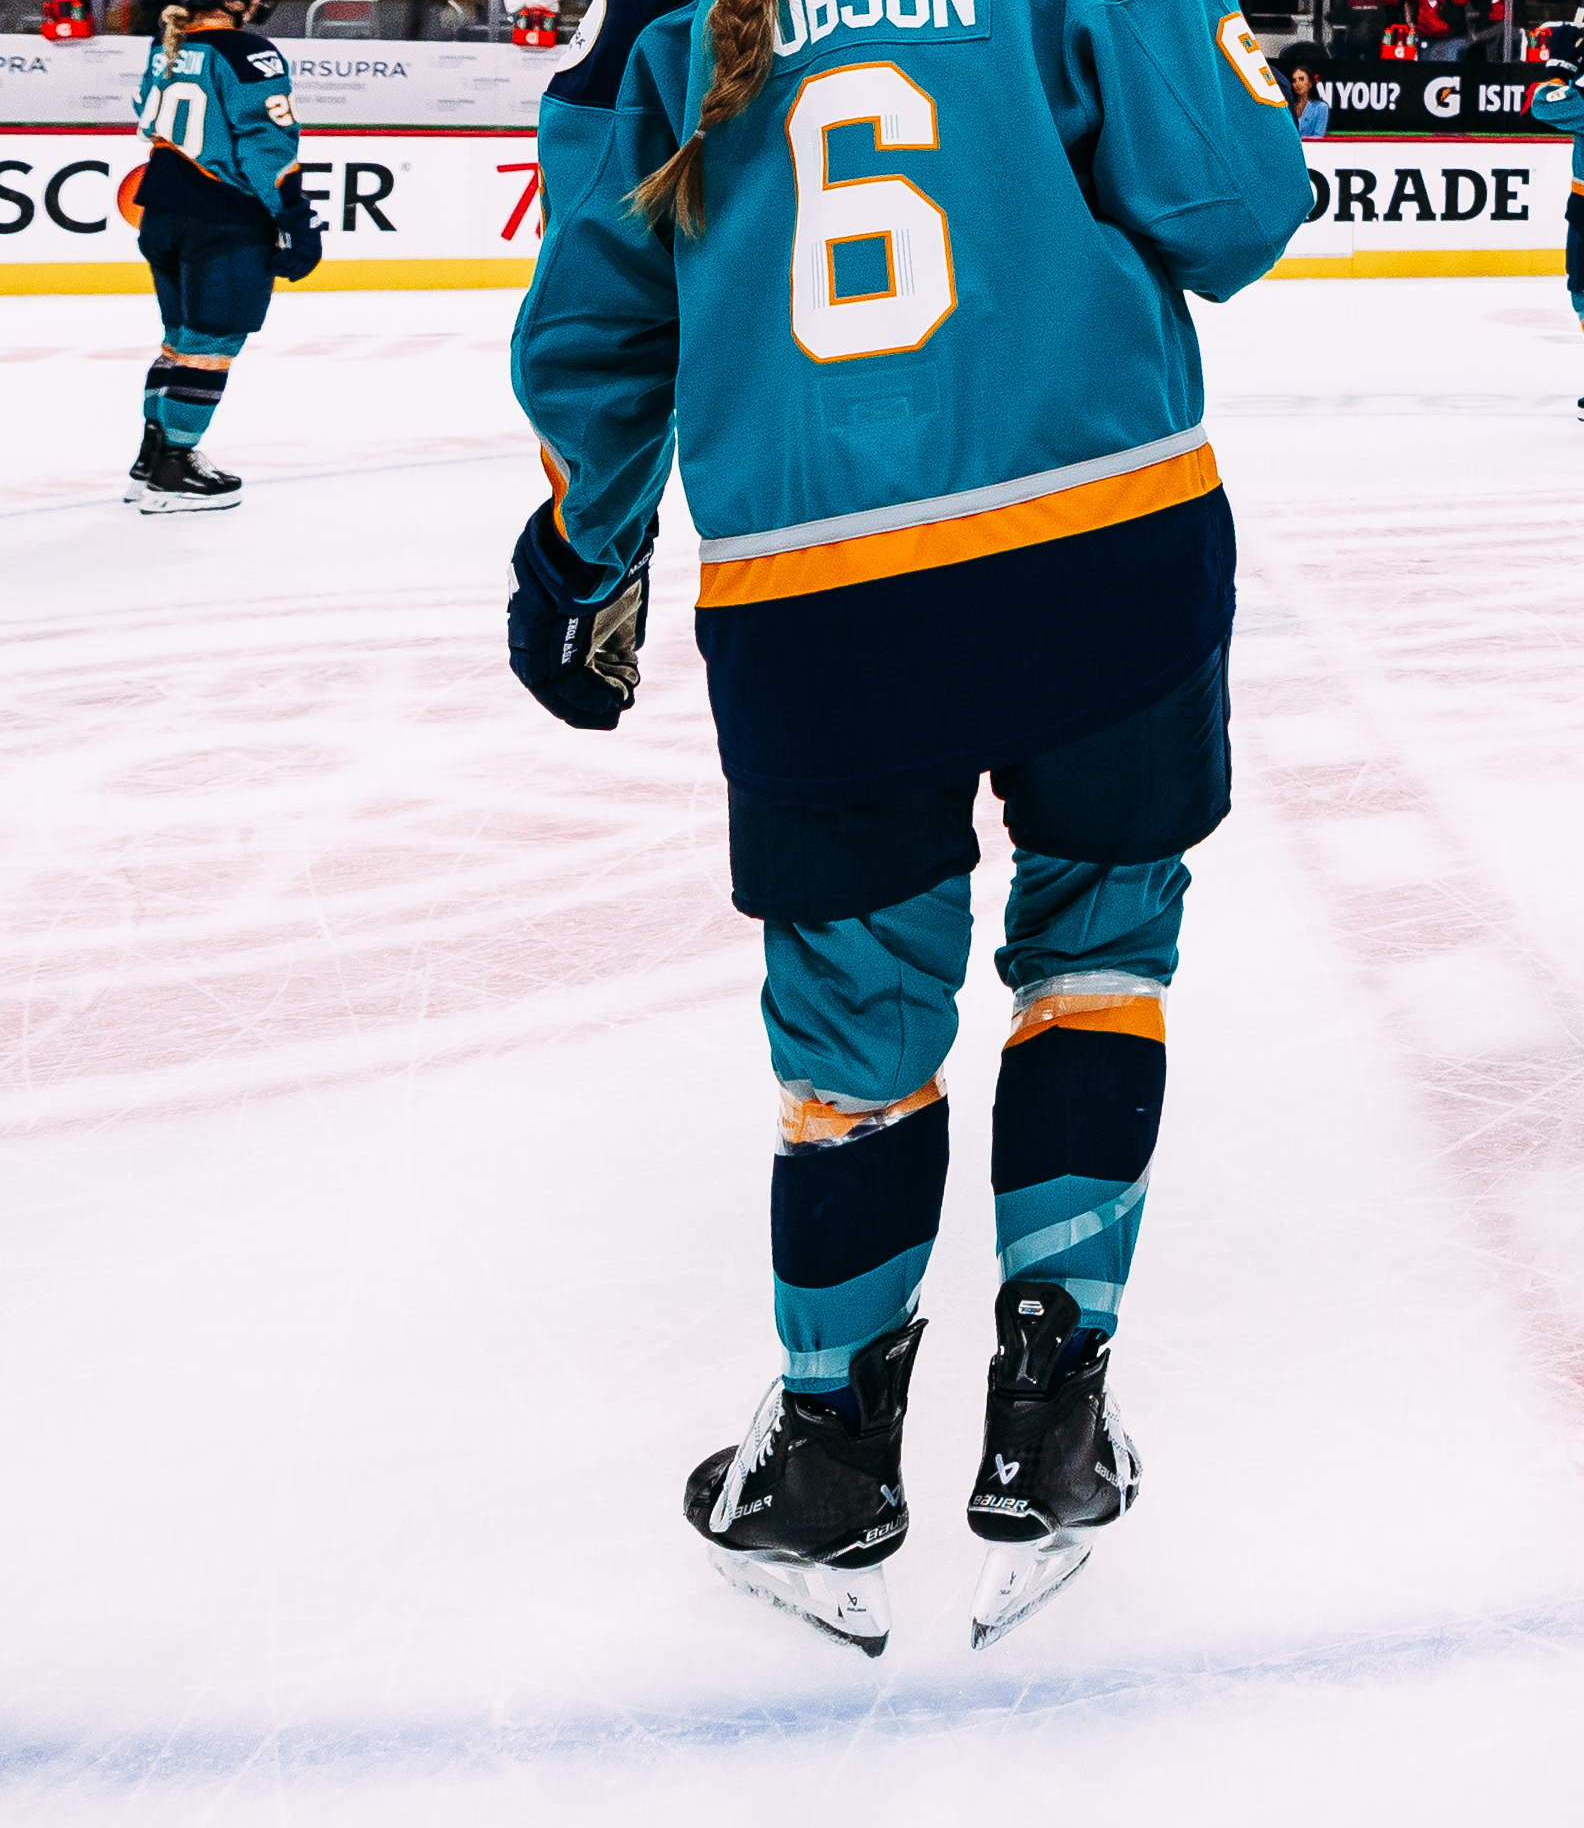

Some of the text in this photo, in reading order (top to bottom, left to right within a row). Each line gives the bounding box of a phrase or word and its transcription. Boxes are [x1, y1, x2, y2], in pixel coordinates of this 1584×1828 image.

[292, 60, 408, 78] IRSUPRA
[1336, 82, 1400, 110] YOU?
[785, 62, 958, 364] 6
[972, 1492, 1029, 1511] BAUER
